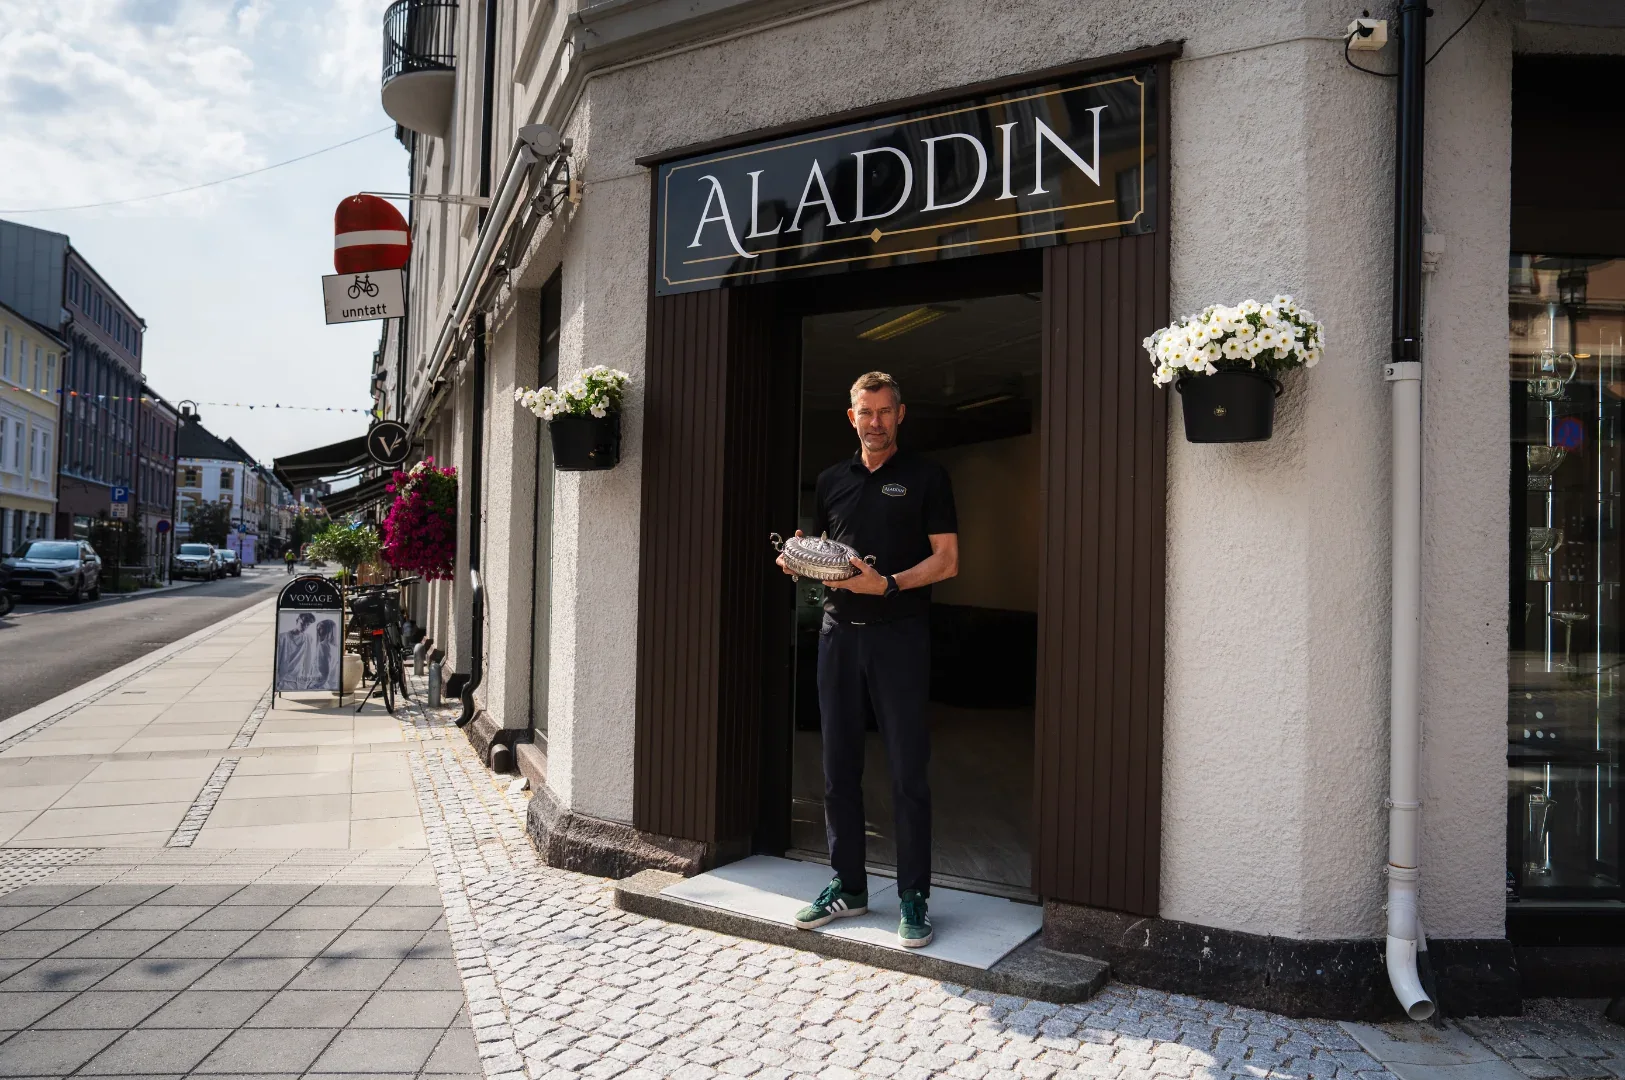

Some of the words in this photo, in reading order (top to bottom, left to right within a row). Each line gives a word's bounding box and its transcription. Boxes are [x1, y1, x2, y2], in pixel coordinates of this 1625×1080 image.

[686, 105, 1109, 258] ALADDIN
[342, 303, 387, 318] unntatt
[115, 488, 124, 500] P
[290, 594, 333, 603] VOYAGE
